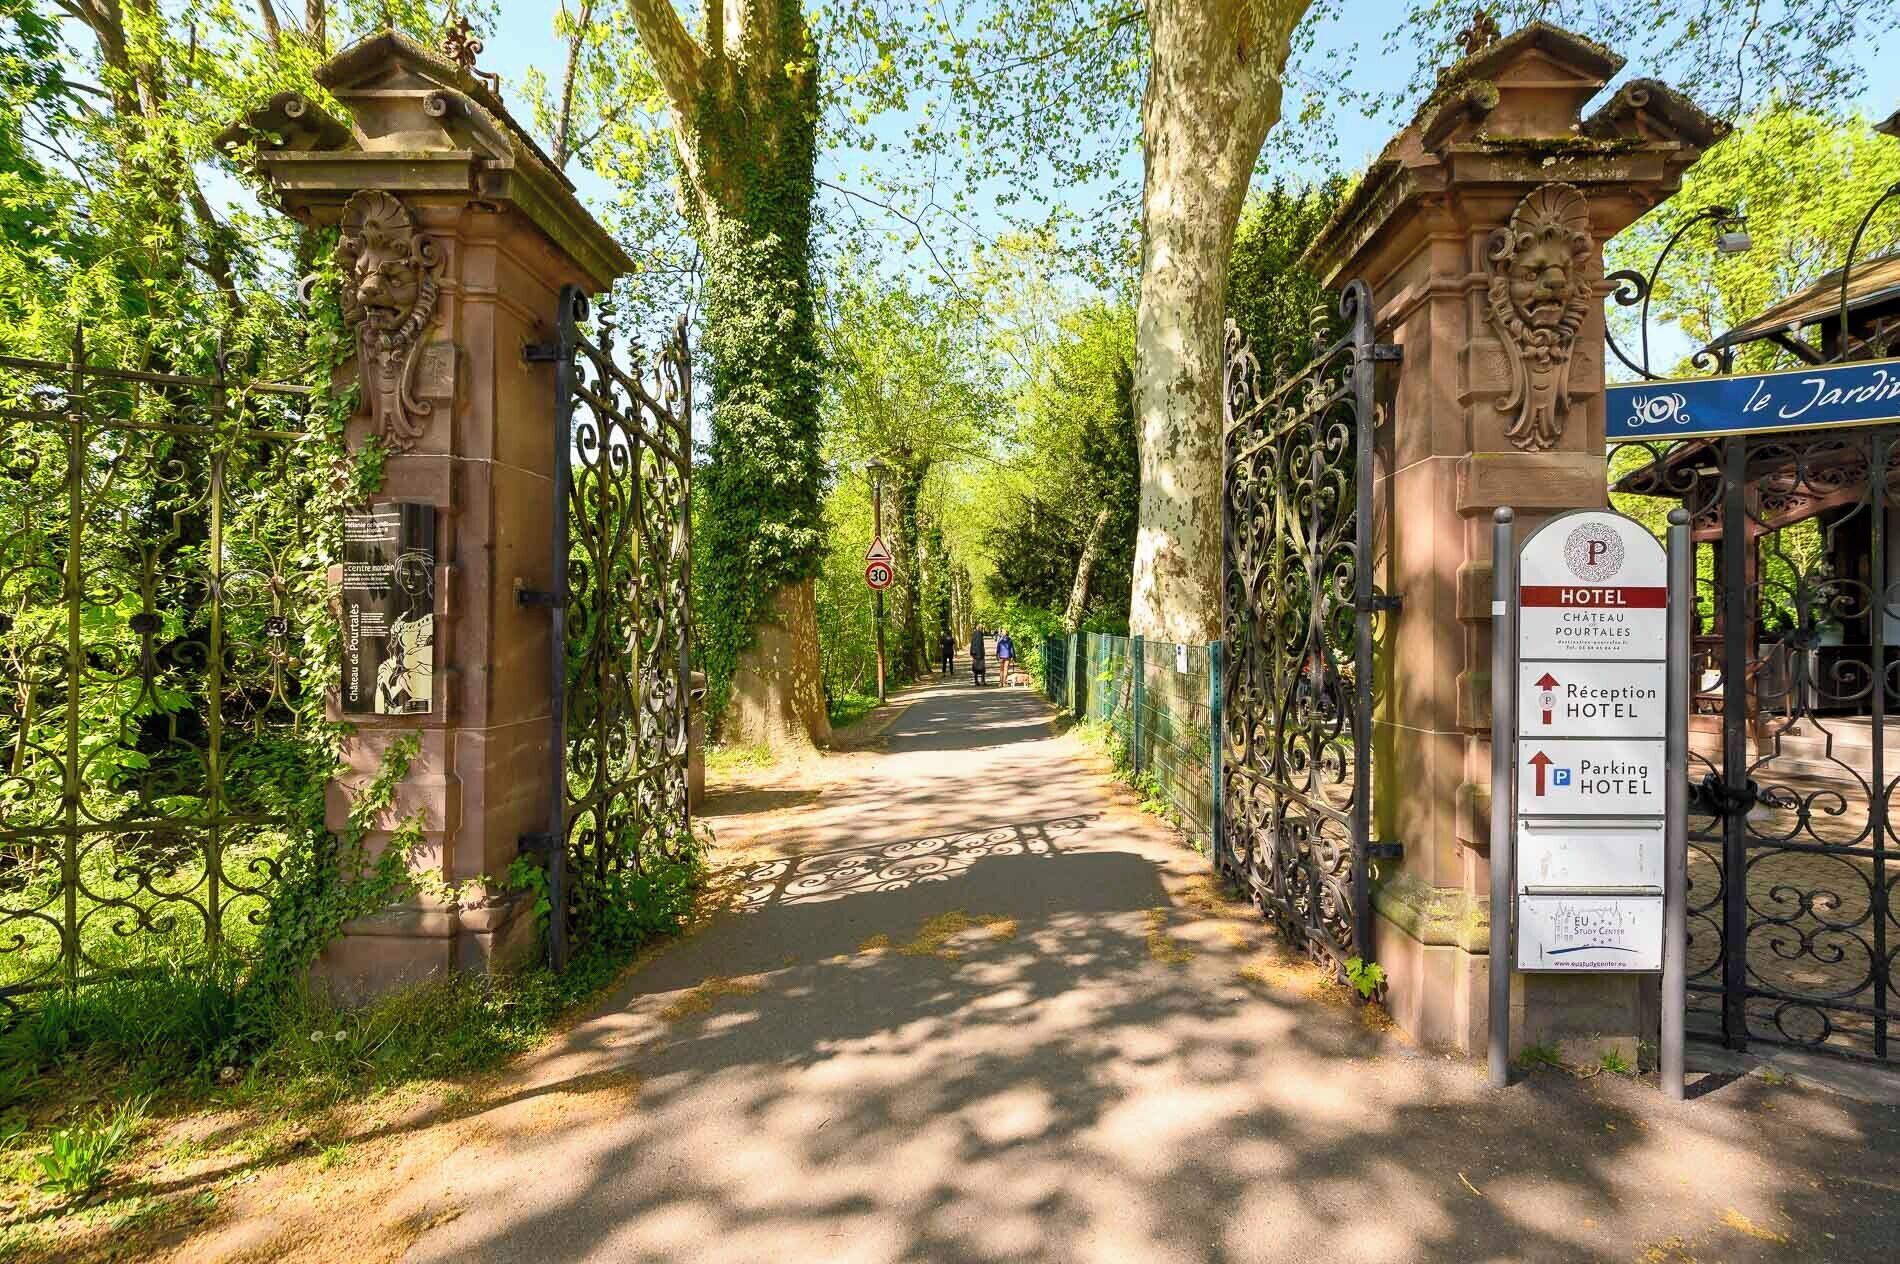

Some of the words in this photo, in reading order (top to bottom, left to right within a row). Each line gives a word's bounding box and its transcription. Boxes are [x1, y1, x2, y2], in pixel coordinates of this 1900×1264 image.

[1743, 379, 1771, 412] le
[1587, 540, 1607, 565] P
[871, 570, 887, 581] 30
[1561, 589, 1627, 605] HOTEL
[1563, 611, 1625, 622] CHÂTEAU
[349, 603, 359, 651] Pourtalès
[1555, 627, 1631, 637] POURTALES
[350, 653, 359, 665] de
[1567, 684, 1656, 702] Réception
[1567, 703, 1638, 718] HOTEL
[1581, 760, 1648, 778] Parking
[1556, 770, 1568, 784] P
[1581, 780, 1652, 795] HOTEL
[1574, 916, 1589, 926] EU
